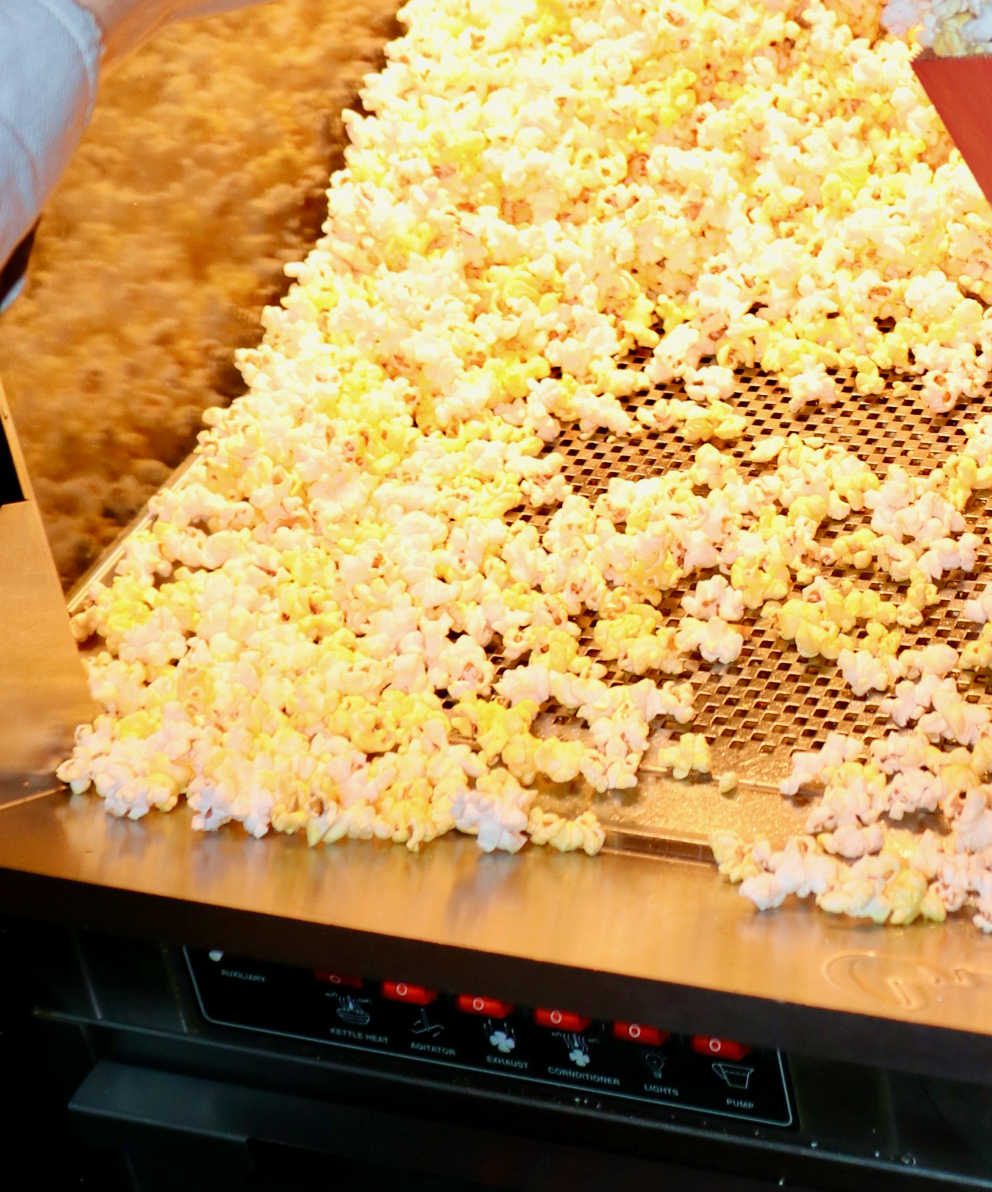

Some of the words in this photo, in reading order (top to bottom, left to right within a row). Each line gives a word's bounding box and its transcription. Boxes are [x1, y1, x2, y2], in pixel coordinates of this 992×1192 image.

[221, 969, 265, 983] AUXILIARY
[330, 1027, 363, 1041] KETTLE
[365, 1033, 389, 1044] HEAT
[410, 1042, 456, 1056] AGITATOR
[486, 1055, 529, 1070] EXHAUST
[548, 1066, 620, 1086] CORNDITIONER
[644, 1083, 679, 1097] LIGHTS
[726, 1098, 754, 1109] PUMP
